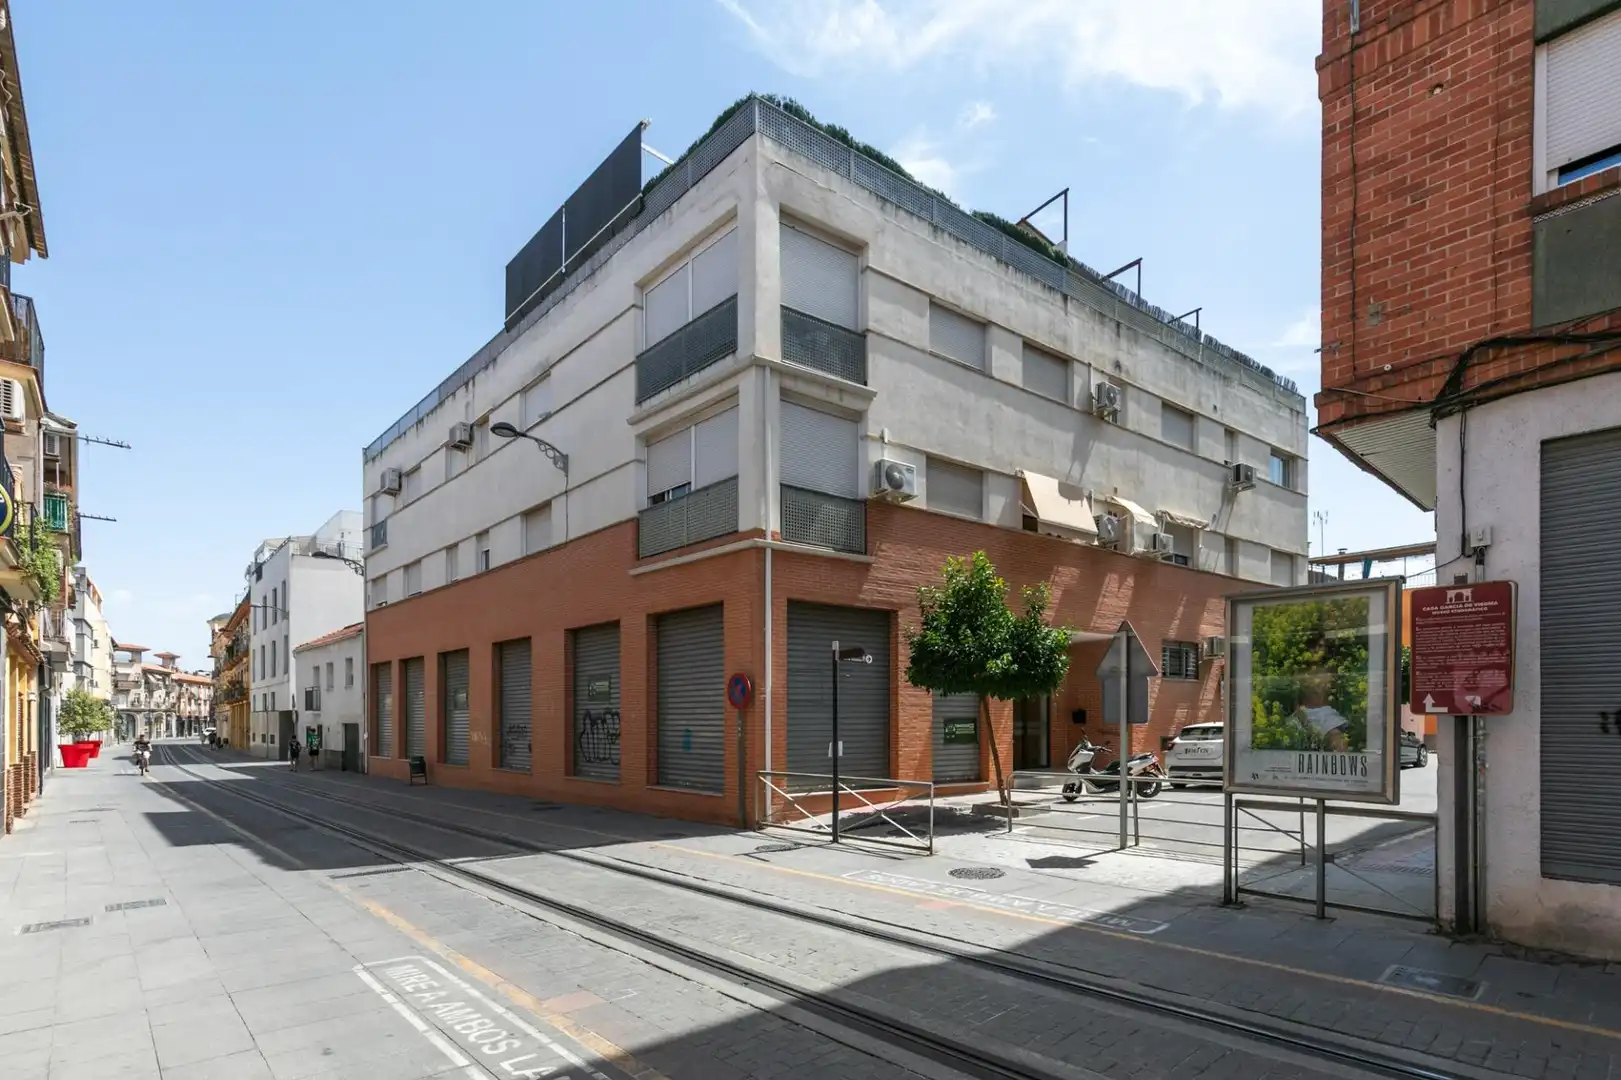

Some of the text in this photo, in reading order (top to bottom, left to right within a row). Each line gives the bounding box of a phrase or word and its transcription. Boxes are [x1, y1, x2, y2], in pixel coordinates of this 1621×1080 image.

[1298, 753, 1368, 778] RAINBOWS
[384, 963, 439, 993] MIRE
[418, 989, 447, 1004] A
[427, 1001, 522, 1055] AMBOS
